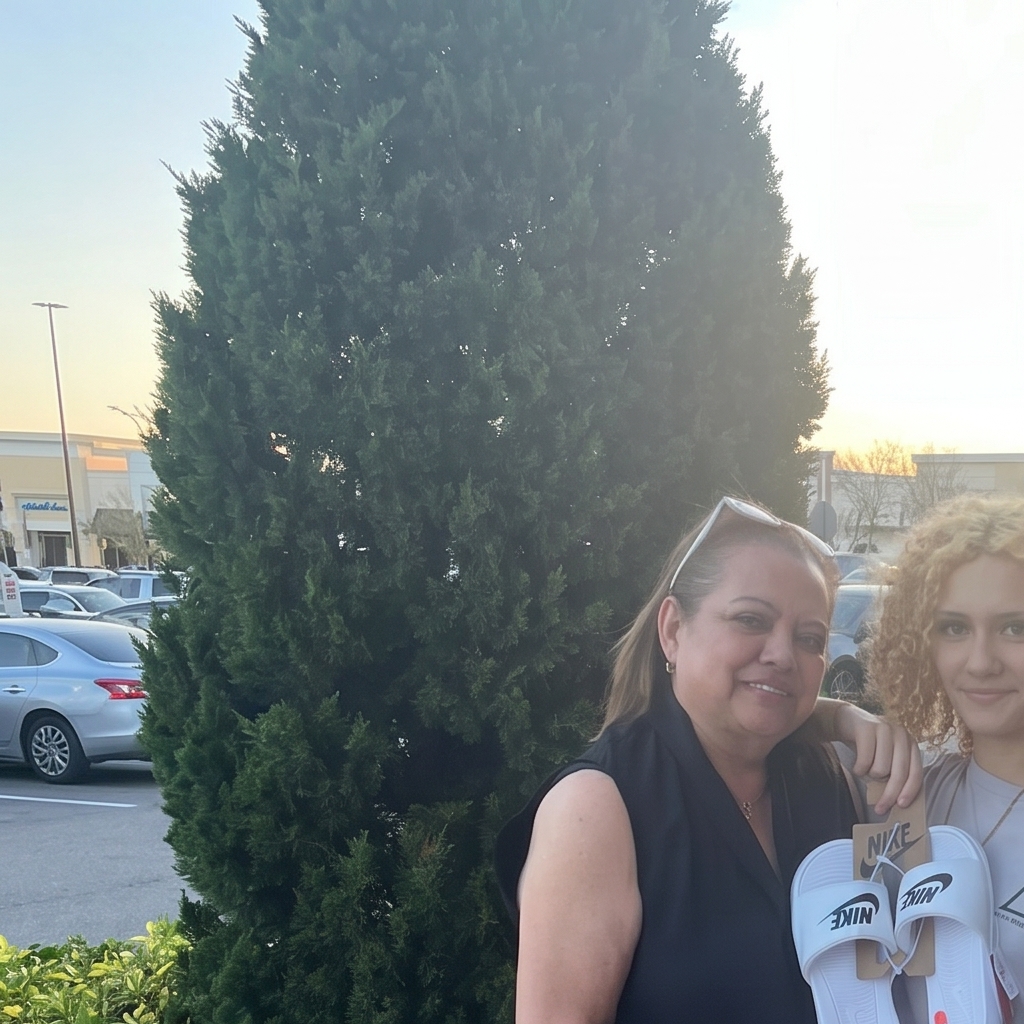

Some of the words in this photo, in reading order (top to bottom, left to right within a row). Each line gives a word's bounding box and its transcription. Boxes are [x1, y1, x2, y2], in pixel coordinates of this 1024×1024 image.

[867, 822, 911, 859] NIKE
[900, 886, 940, 912] NIKE
[831, 907, 873, 931] NIKE
